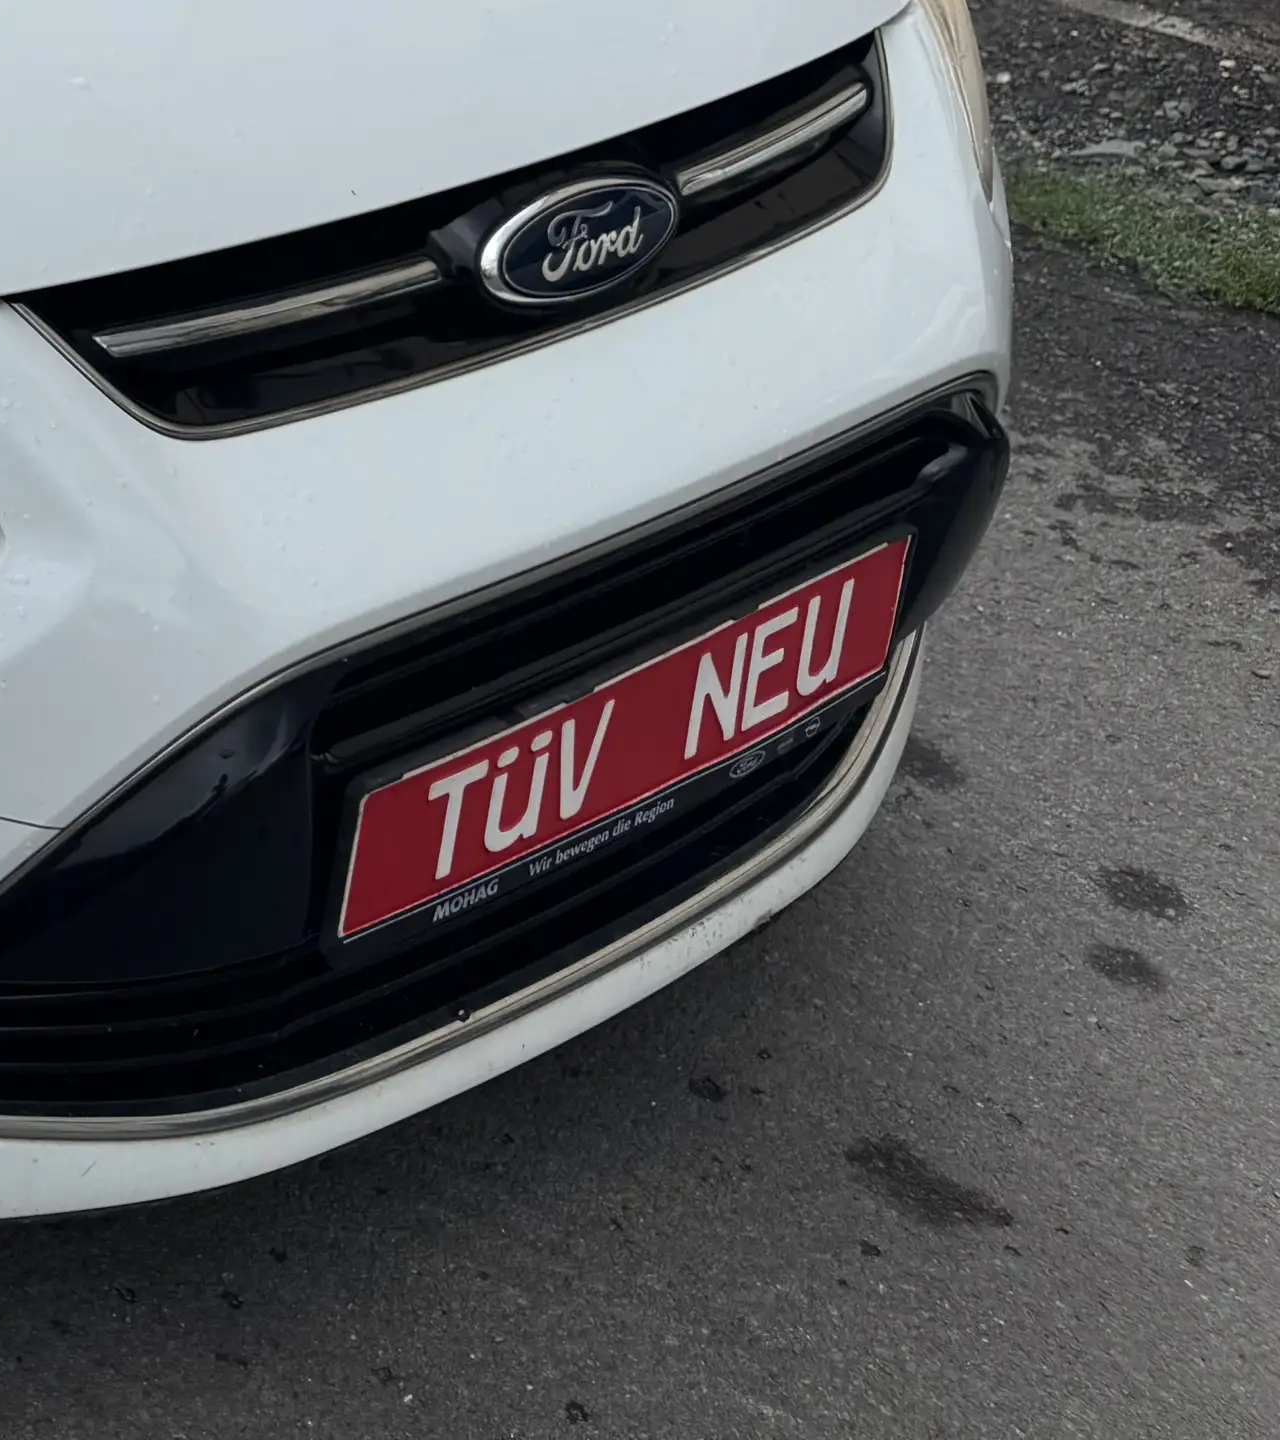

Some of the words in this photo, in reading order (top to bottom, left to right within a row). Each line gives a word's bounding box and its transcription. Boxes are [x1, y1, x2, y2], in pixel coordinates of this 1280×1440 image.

[542, 201, 643, 283] Ford
[428, 698, 615, 880] TÜV
[684, 578, 855, 759] NEU
[528, 858, 553, 878] Wir
[555, 829, 610, 865] bewegen
[611, 820, 632, 838] die
[634, 797, 675, 827] Region
[432, 879, 499, 922] MOHAG
